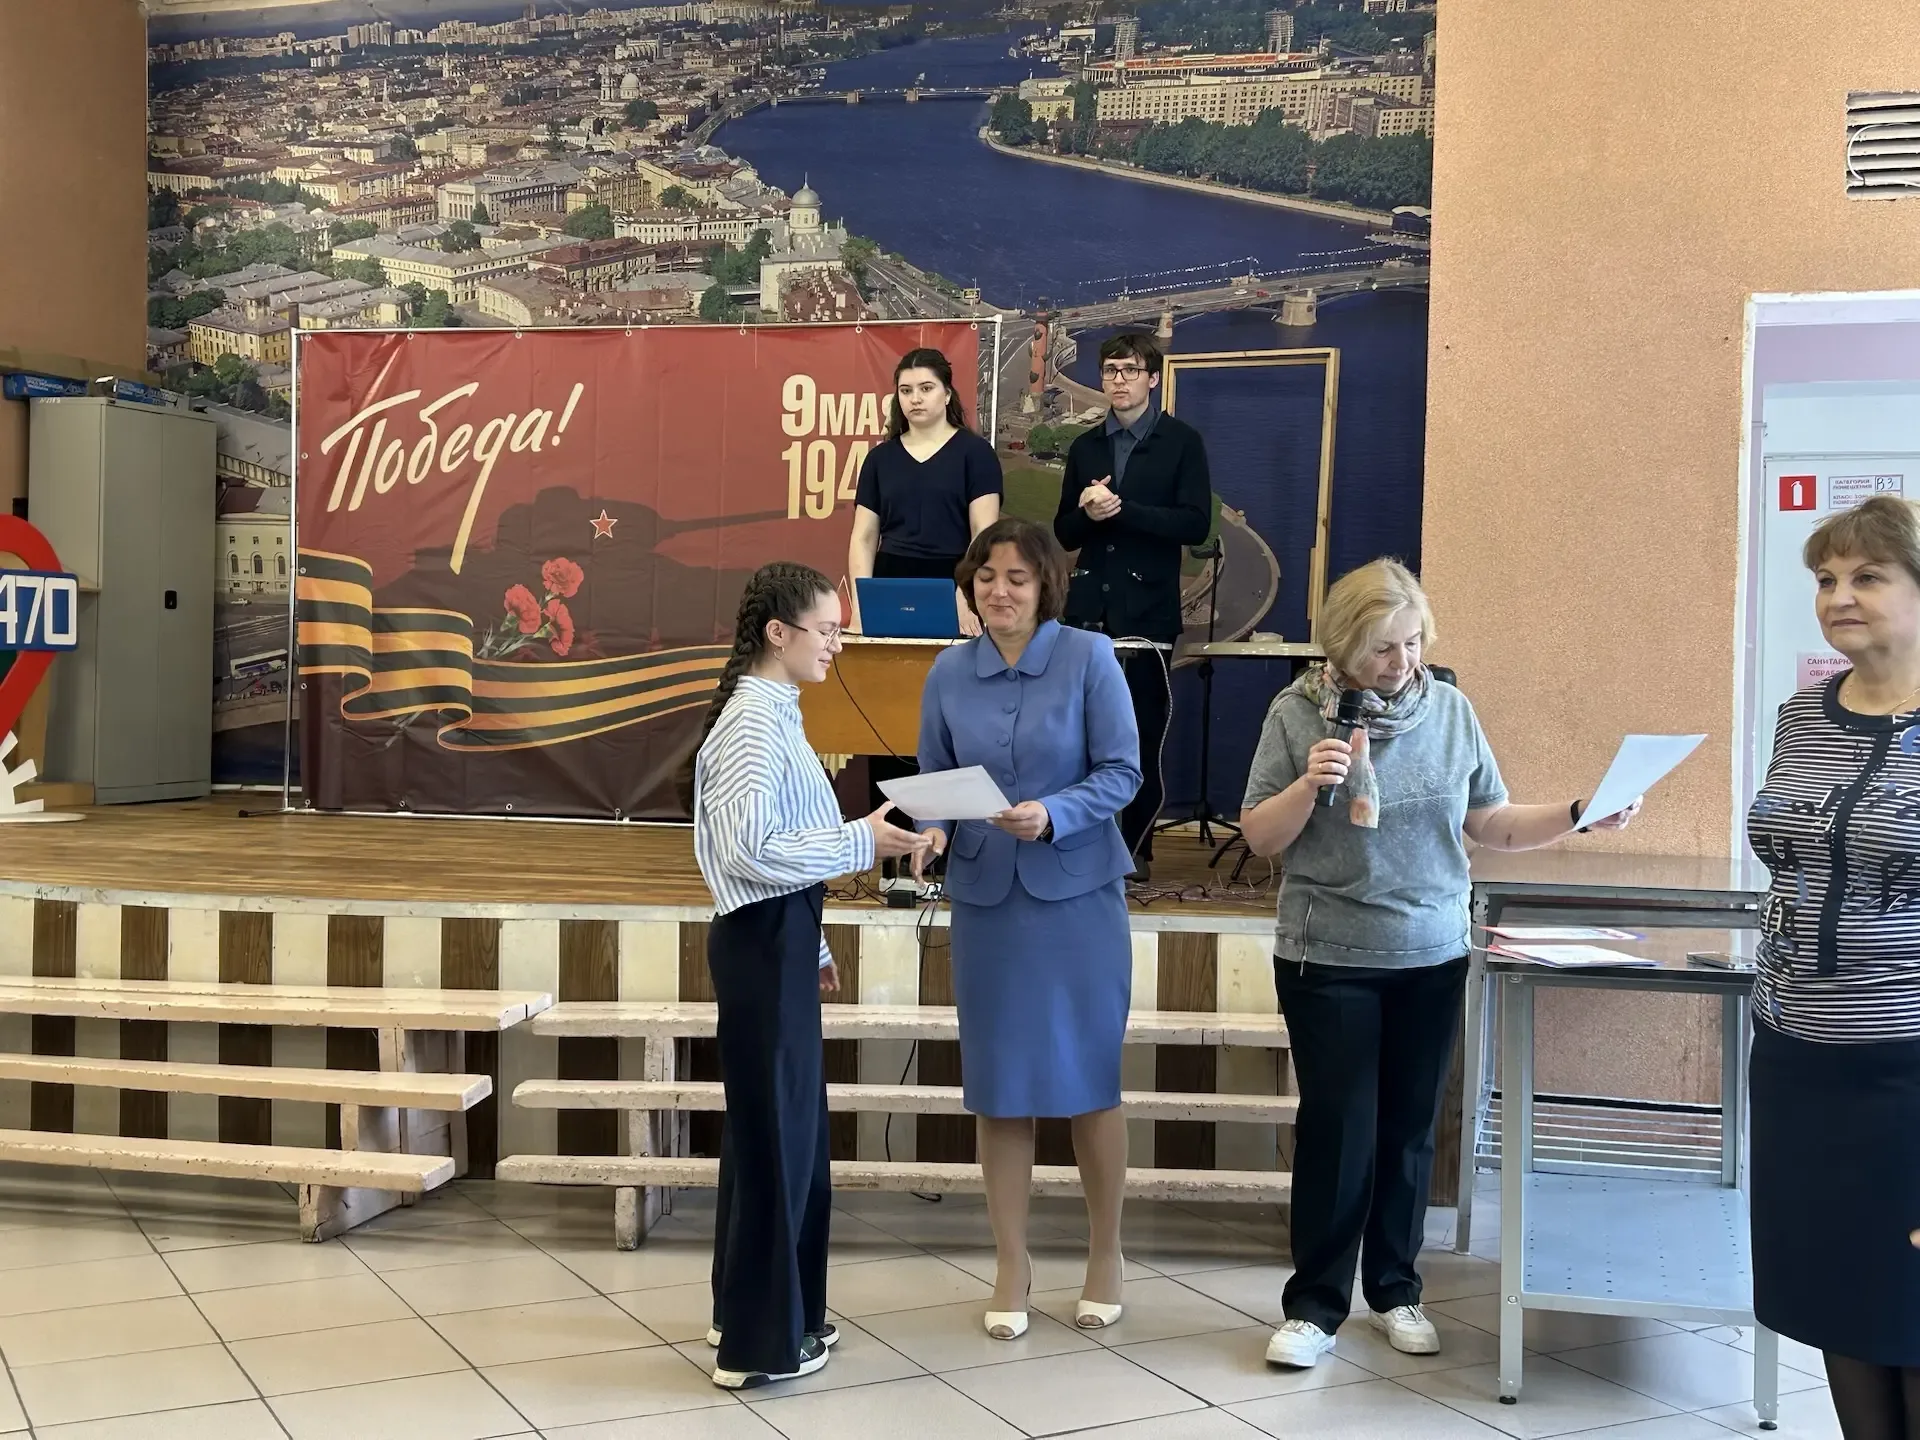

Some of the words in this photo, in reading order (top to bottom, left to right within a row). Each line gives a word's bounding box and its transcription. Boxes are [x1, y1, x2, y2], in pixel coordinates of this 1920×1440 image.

[781, 374, 817, 437] 9
[320, 382, 585, 575] Победа!
[781, 440, 884, 520] 194
[0, 574, 77, 645] 470
